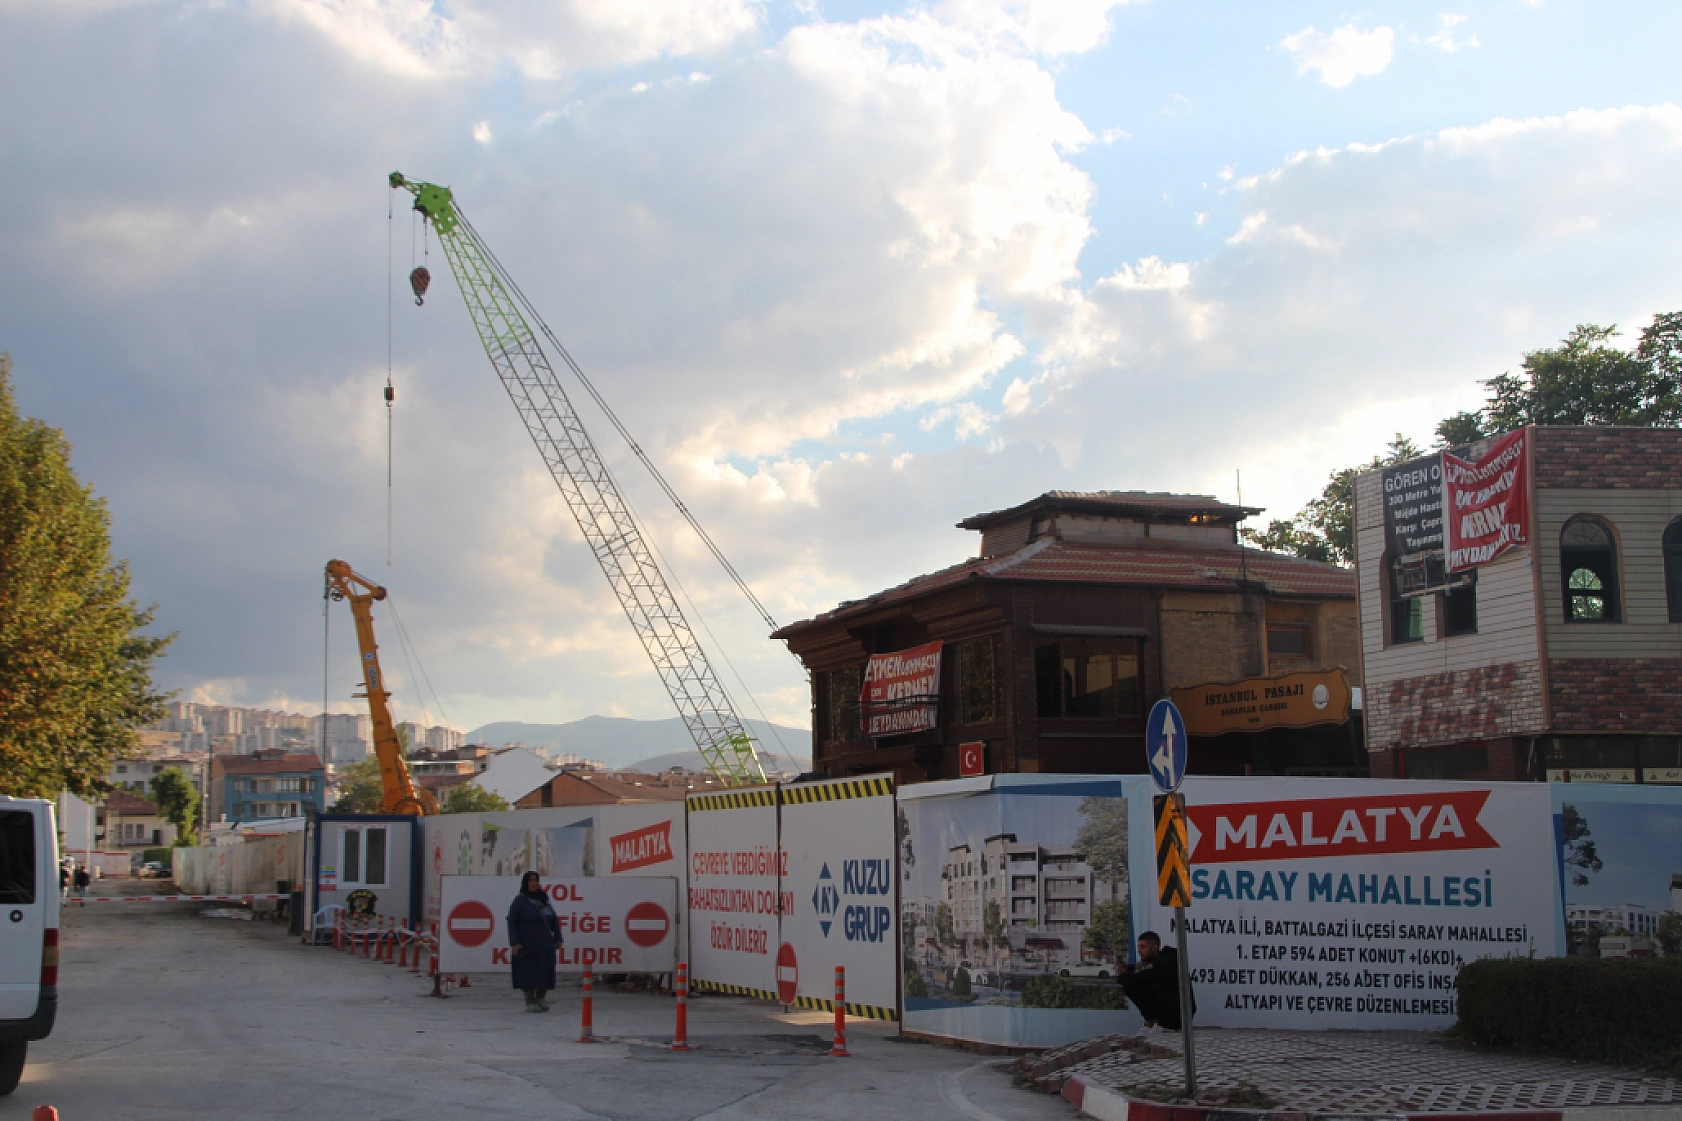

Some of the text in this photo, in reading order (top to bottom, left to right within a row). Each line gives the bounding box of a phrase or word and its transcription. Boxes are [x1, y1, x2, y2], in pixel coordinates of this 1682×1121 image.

[1385, 468, 1427, 492] GÖREN
[1205, 684, 1304, 706] İSTANBUL PASAJI
[1215, 804, 1466, 851] MALATYA
[615, 831, 666, 865] MALATYA
[693, 852, 729, 881] ÇEVREYE
[843, 858, 890, 896] KUZU
[539, 883, 584, 901] YOL
[689, 886, 755, 913] RAHATSIZLIKTAN
[1191, 868, 1492, 908] SARAY MAHALLESİ
[844, 904, 891, 943] GRUP
[1264, 918, 1348, 938] BATTALGAZİ
[1352, 919, 1395, 941] İLÇESİ
[1399, 924, 1444, 940] SARAY
[1448, 923, 1528, 943] MAHALLESİ
[710, 920, 768, 955] ÖZÜR DİLERİZ
[491, 947, 623, 965] KLIDIR
[1236, 944, 1248, 960] 1.
[1251, 945, 1287, 960] ETAP
[1290, 946, 1315, 962] 594
[1318, 947, 1356, 962] ADET
[1359, 948, 1407, 964] KONUT
[1218, 969, 1256, 985] ADET
[1259, 966, 1322, 989] DÜKKAN,
[1326, 971, 1350, 987] 256
[1353, 970, 1390, 988] ADET
[1393, 971, 1425, 990] OFİS
[1224, 994, 1454, 1016] ALTYAPI VE ÇEVRE DÜZENLEMESİ
